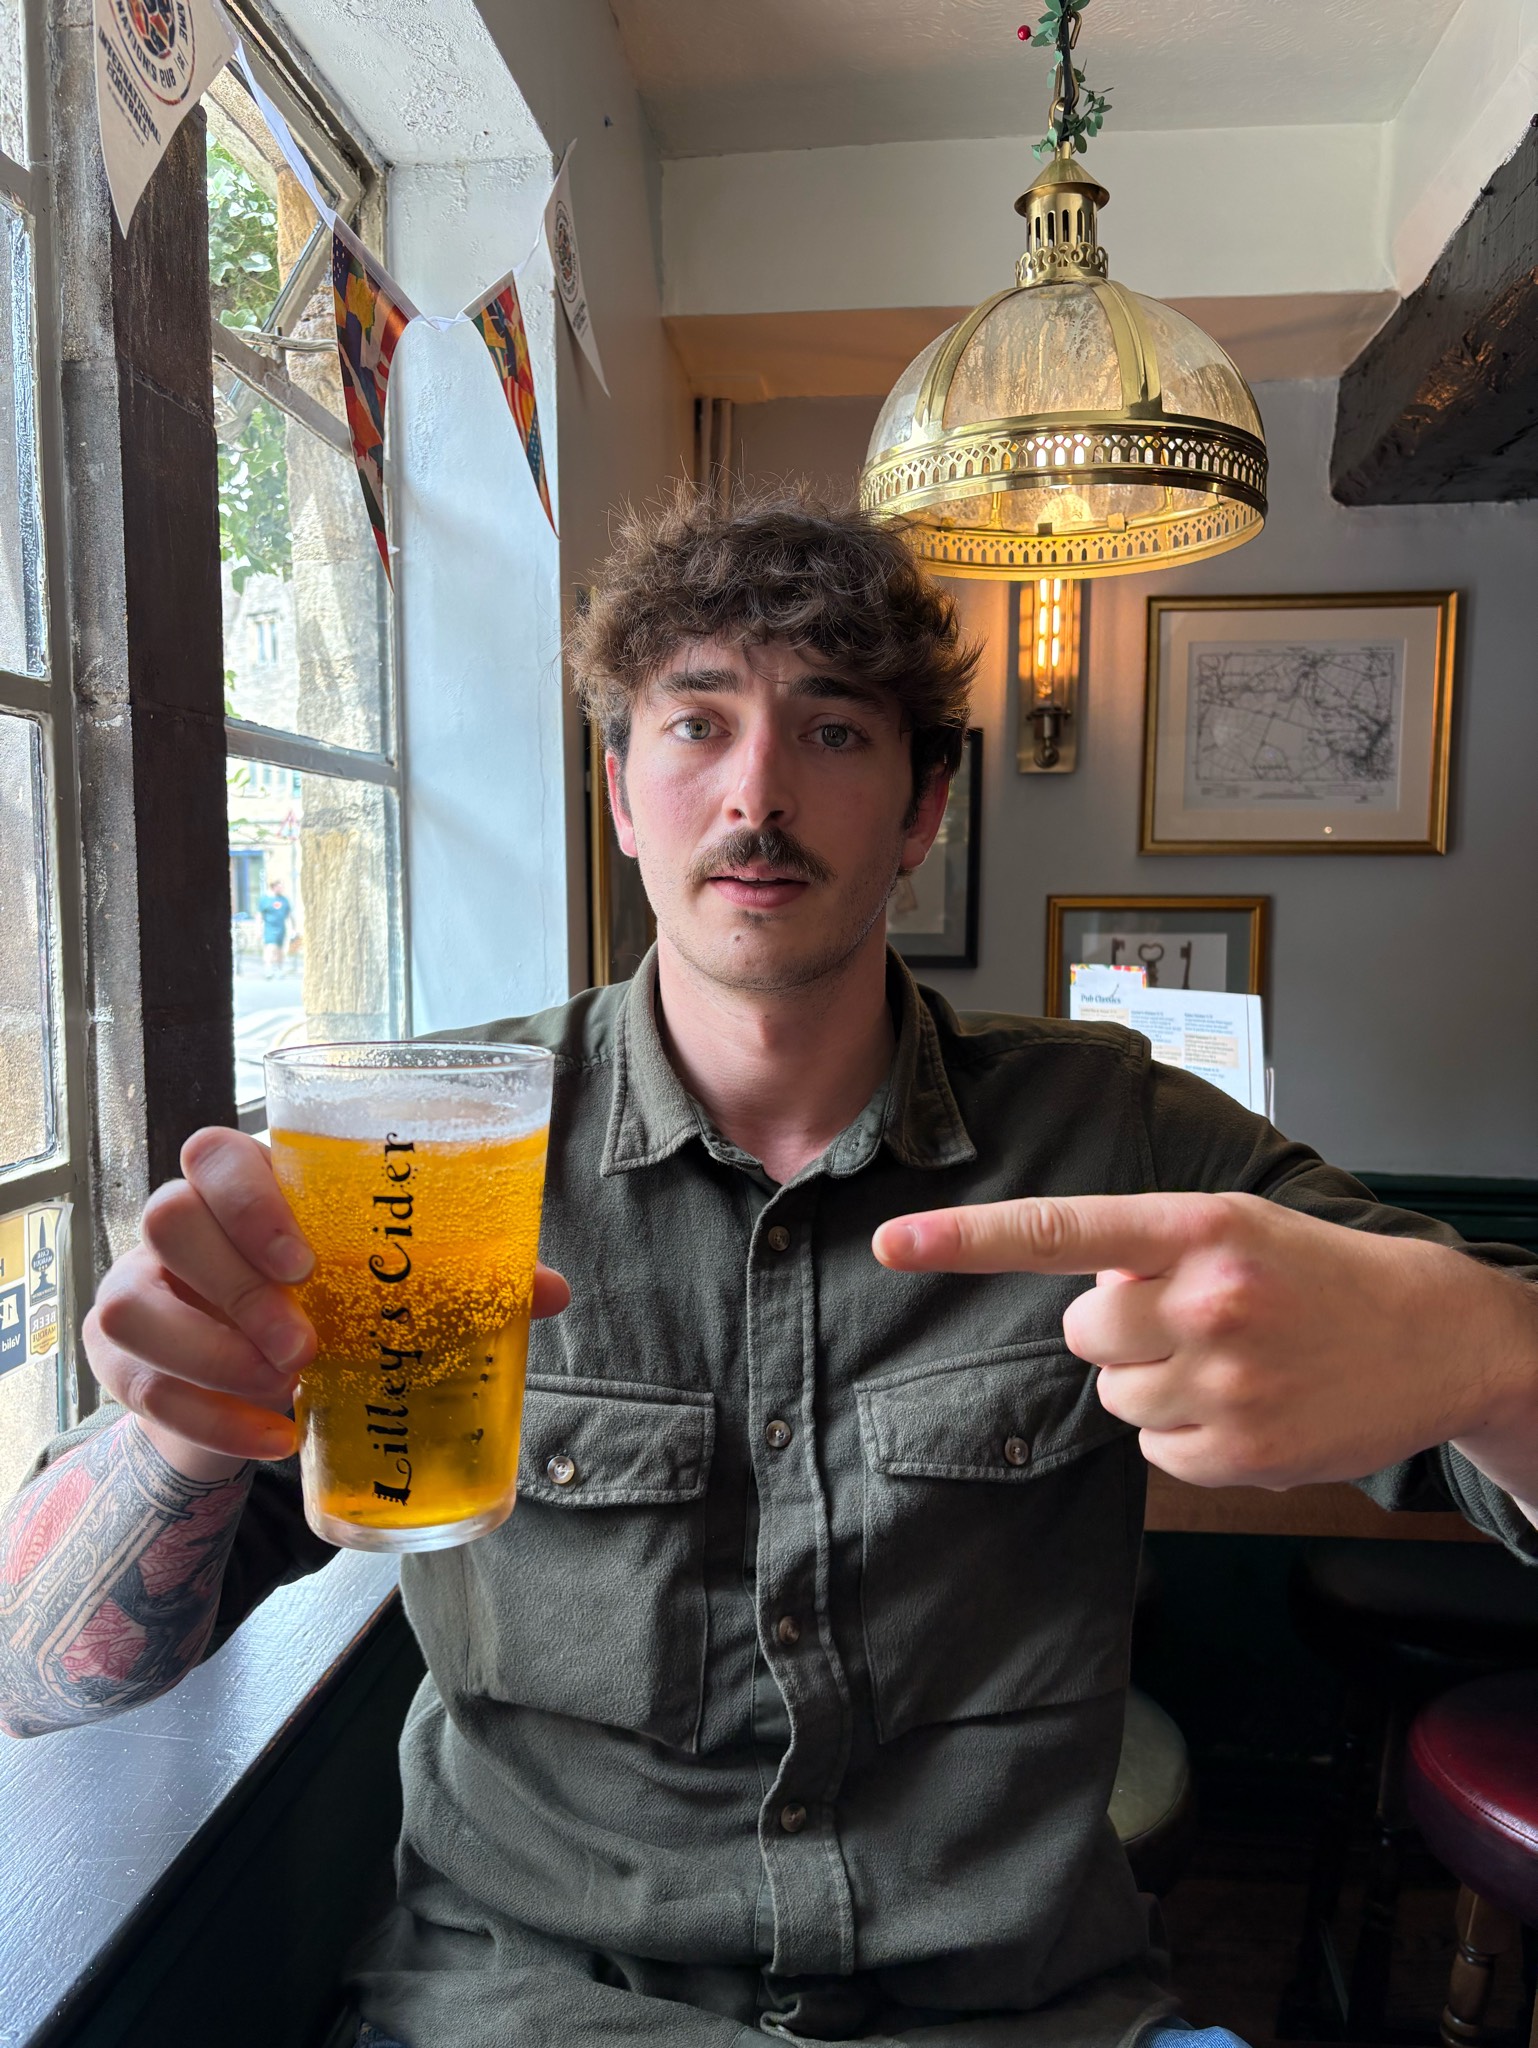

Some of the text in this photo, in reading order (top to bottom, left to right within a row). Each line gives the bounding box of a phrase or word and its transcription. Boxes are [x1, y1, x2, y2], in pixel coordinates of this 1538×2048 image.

[176, 0, 188, 46] AME
[98, 26, 161, 145] INTERNATIONAL
[107, 59, 149, 141] FOOTBALL
[159, 67, 177, 88] PUB
[1080, 994, 1121, 1004] Pub Classics
[364, 1132, 423, 1506] Lilley's Cider
